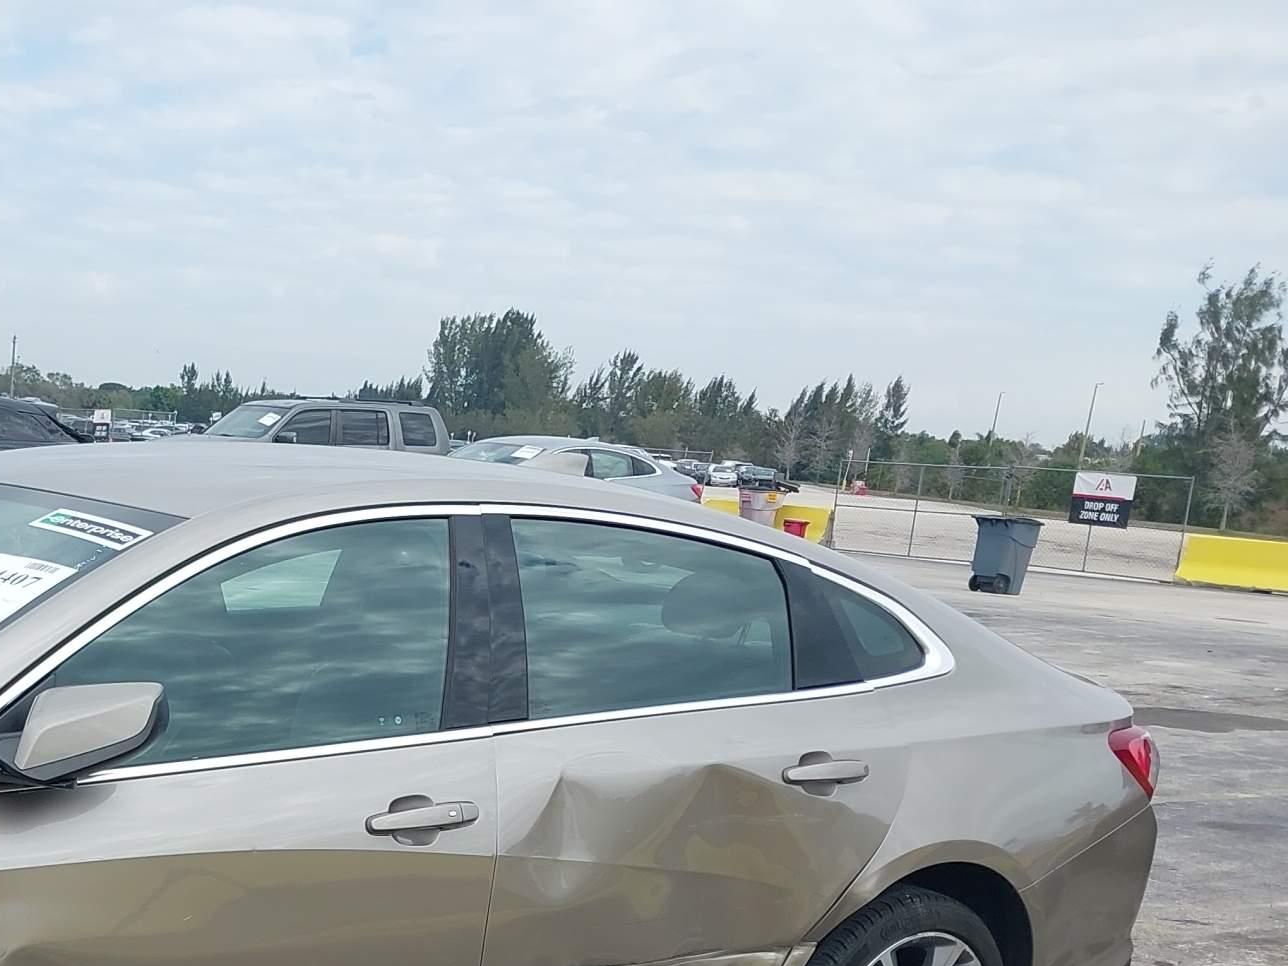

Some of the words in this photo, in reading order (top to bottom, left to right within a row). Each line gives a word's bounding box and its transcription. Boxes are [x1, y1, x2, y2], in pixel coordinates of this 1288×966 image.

[1084, 501, 1104, 511] DROP
[1105, 503, 1119, 512] OFF
[1079, 510, 1099, 521] ZONE
[1099, 513, 1120, 522] ONLY
[48, 514, 134, 543] enterprise
